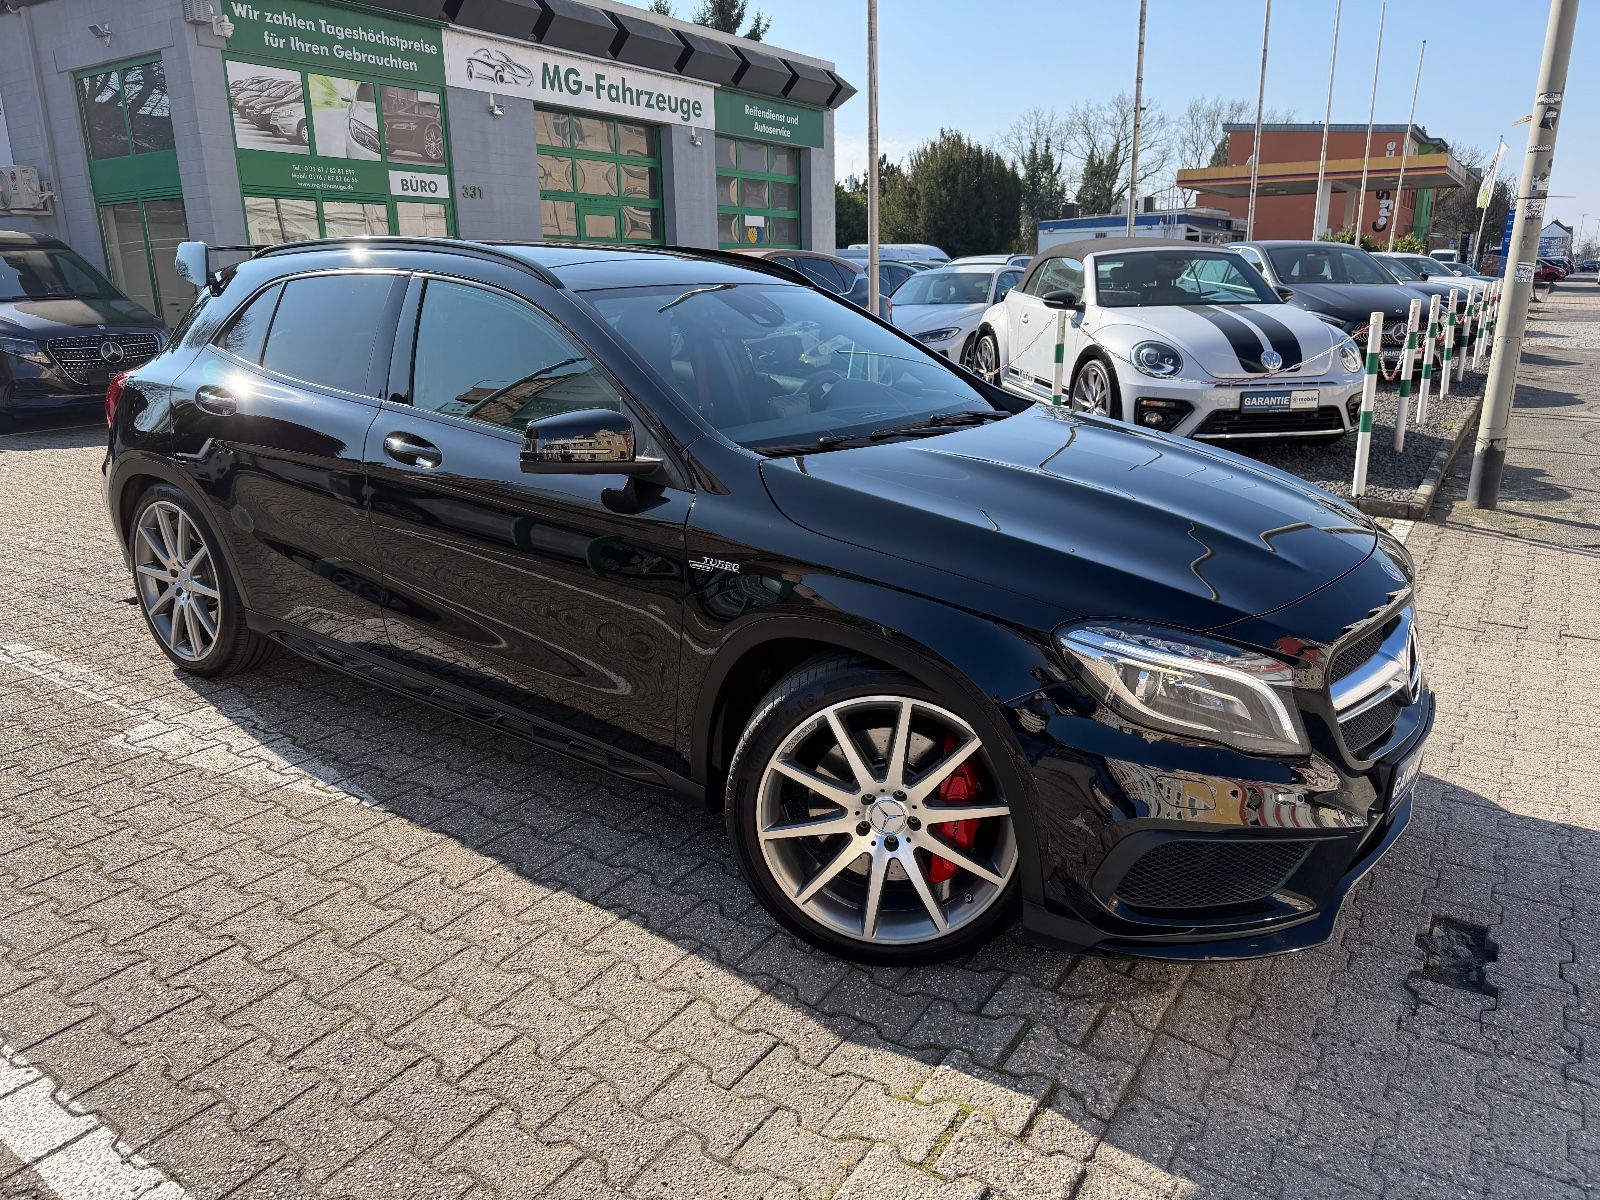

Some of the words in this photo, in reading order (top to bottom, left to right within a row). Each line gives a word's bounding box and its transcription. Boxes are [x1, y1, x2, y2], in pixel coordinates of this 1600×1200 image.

[231, 2, 260, 20] Wir
[264, 11, 316, 31] zahlen
[319, 19, 438, 54] Tageshöchstpreise
[263, 31, 286, 48] für
[290, 37, 329, 56] Ihren
[333, 44, 417, 71] Gebrauchten
[541, 62, 702, 122] MG-Fahrzeuge
[744, 104, 786, 122] Reifendienst
[786, 114, 799, 125] und
[753, 121, 791, 138] Autoservice
[400, 175, 438, 193] BÜRO
[462, 184, 483, 199] 331
[1244, 396, 1290, 406] GARANTIE
